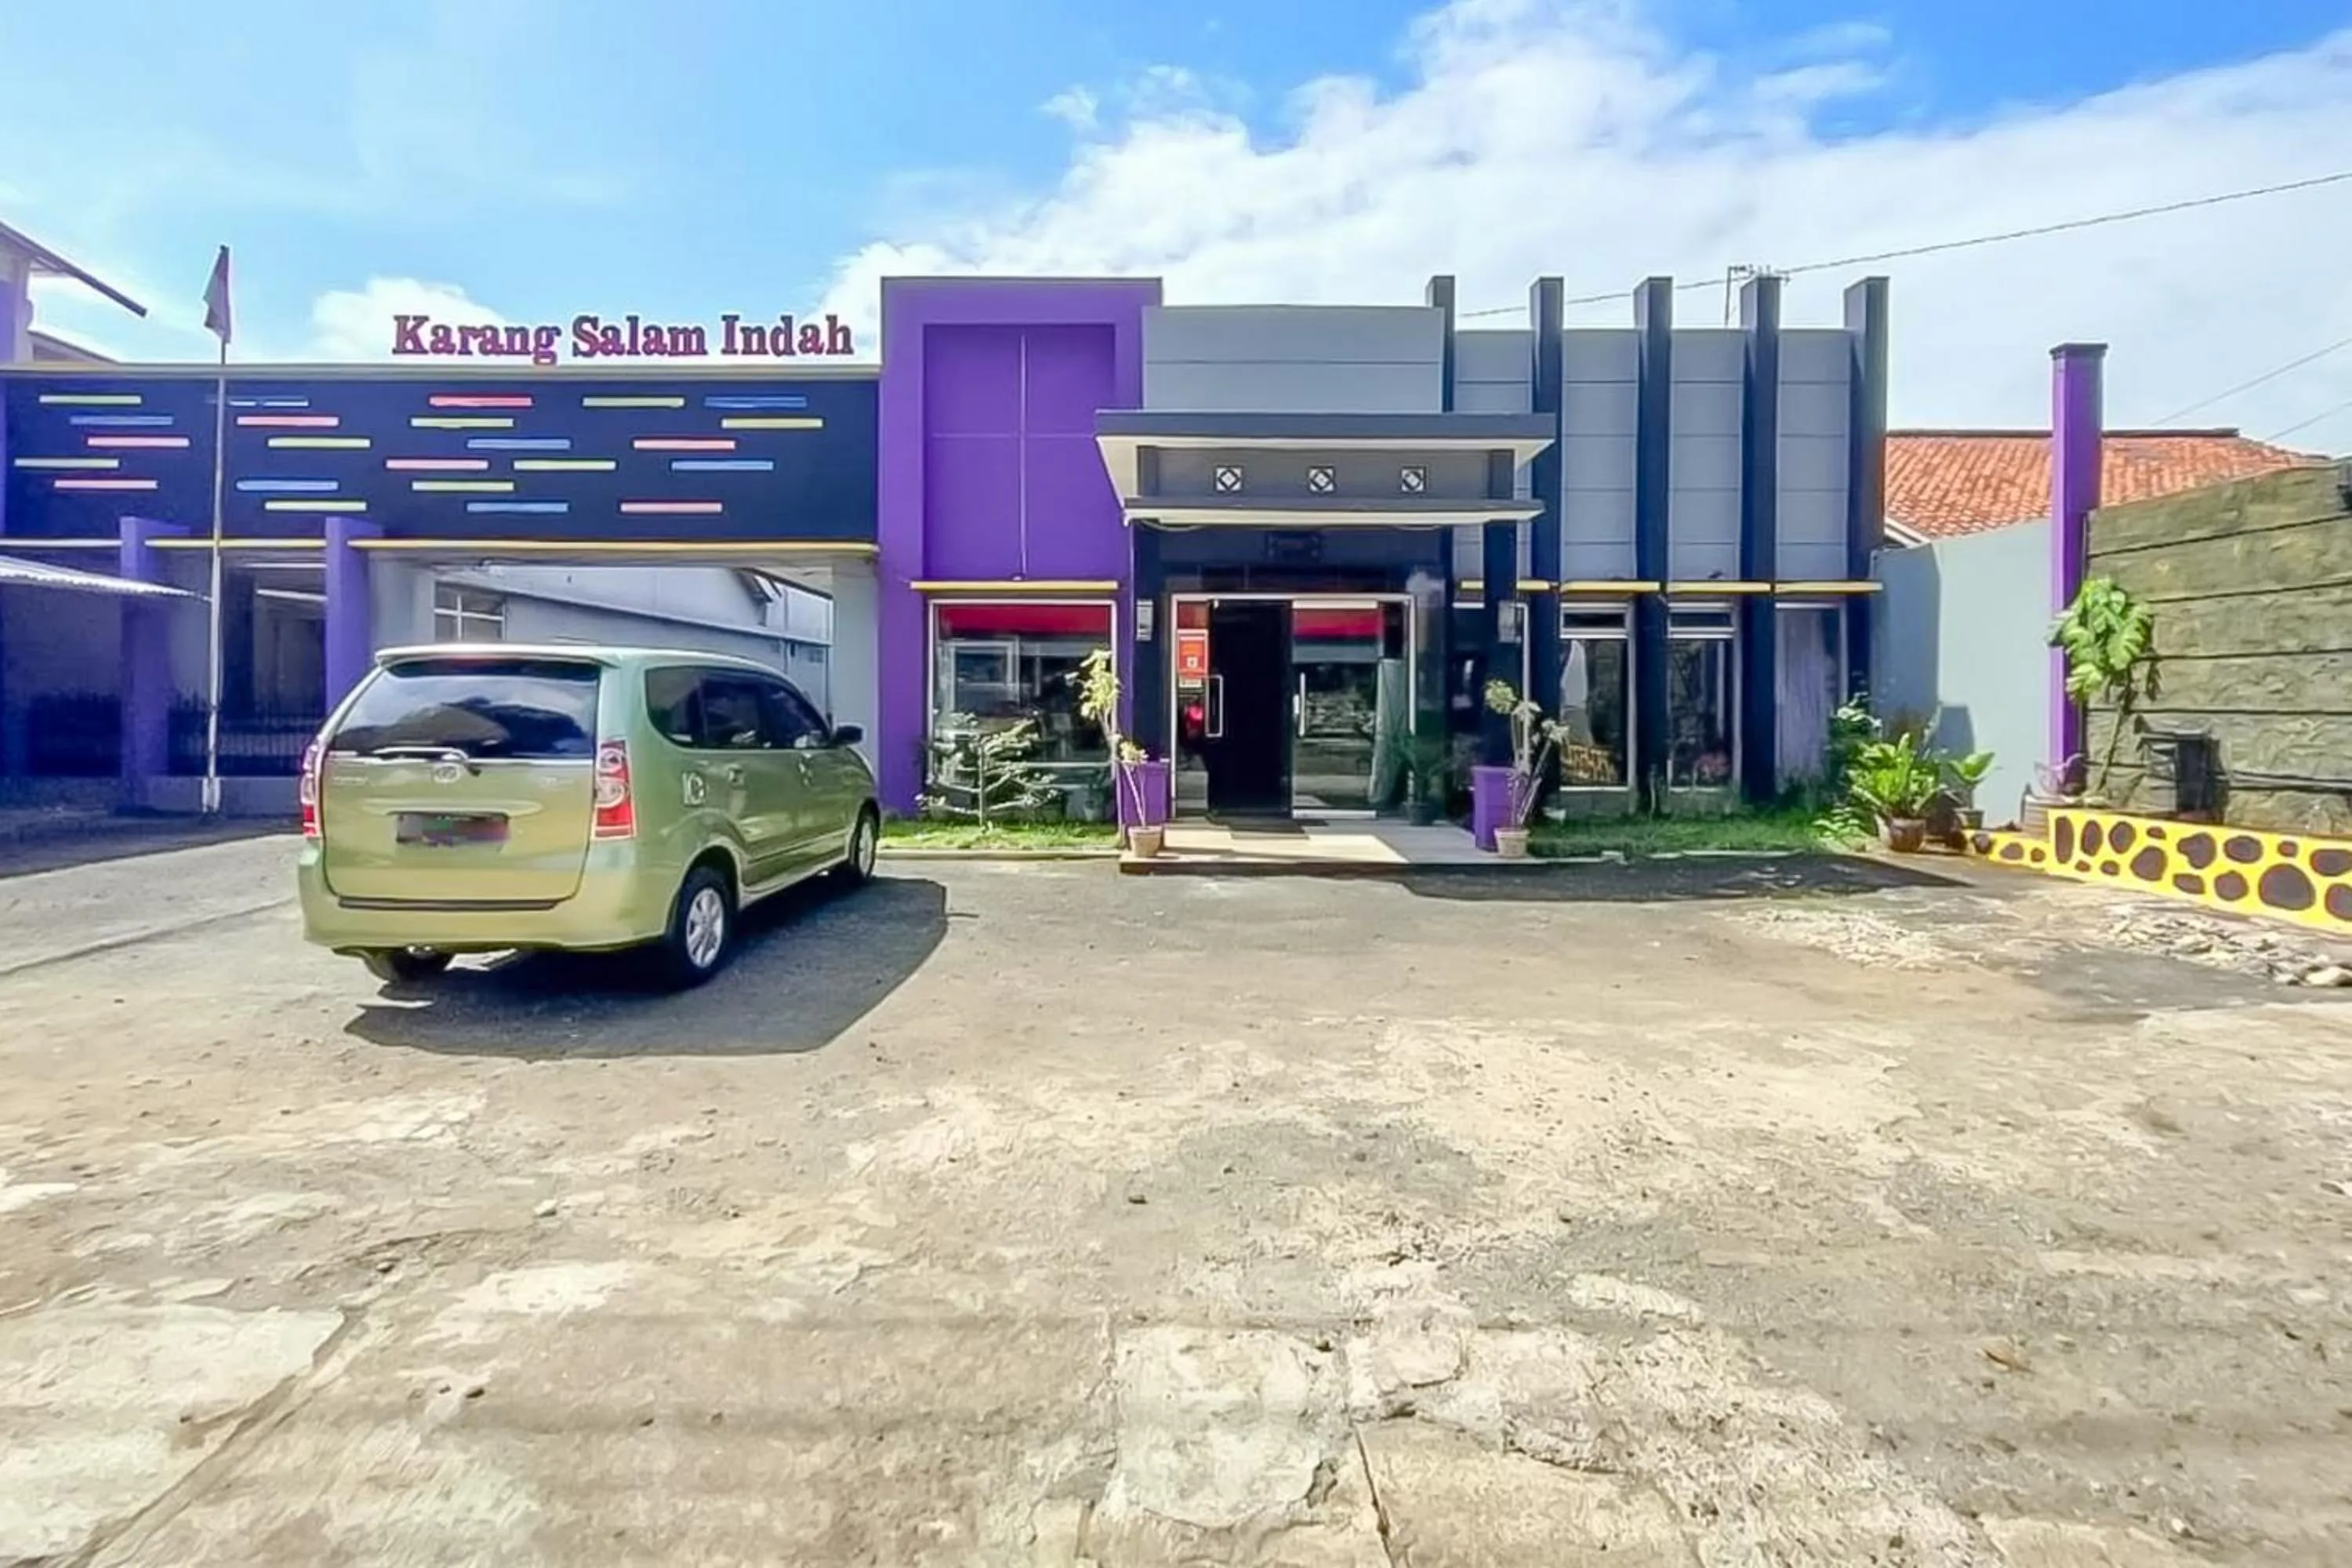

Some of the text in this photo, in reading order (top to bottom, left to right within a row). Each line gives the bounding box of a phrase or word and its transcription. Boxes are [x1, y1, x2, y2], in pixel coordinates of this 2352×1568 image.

[392, 314, 854, 364] Karang Salam Indah
